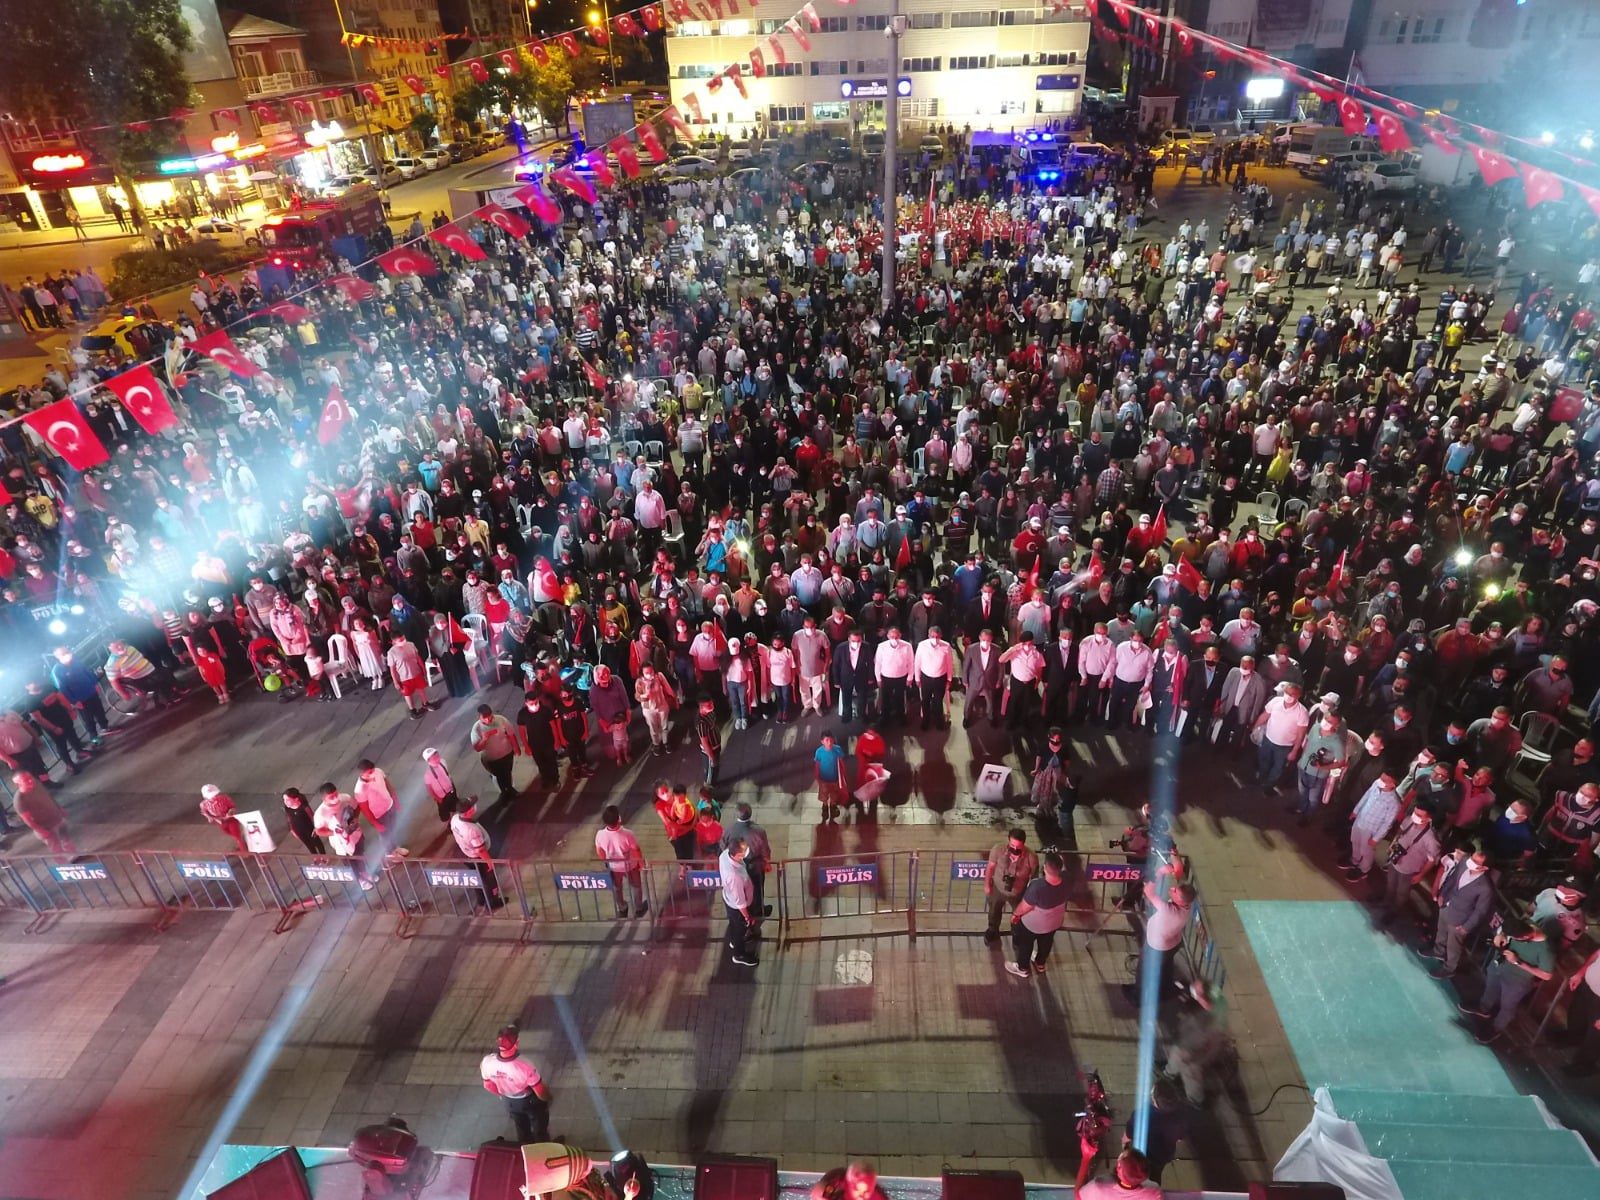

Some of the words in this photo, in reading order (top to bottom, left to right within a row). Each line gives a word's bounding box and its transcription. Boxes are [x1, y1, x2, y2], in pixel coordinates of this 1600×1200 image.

[825, 867, 873, 884] POLİS
[957, 868, 987, 878] POL
[1091, 867, 1141, 880] POLİS
[431, 873, 479, 887] POLİS
[560, 876, 607, 889] POLİS
